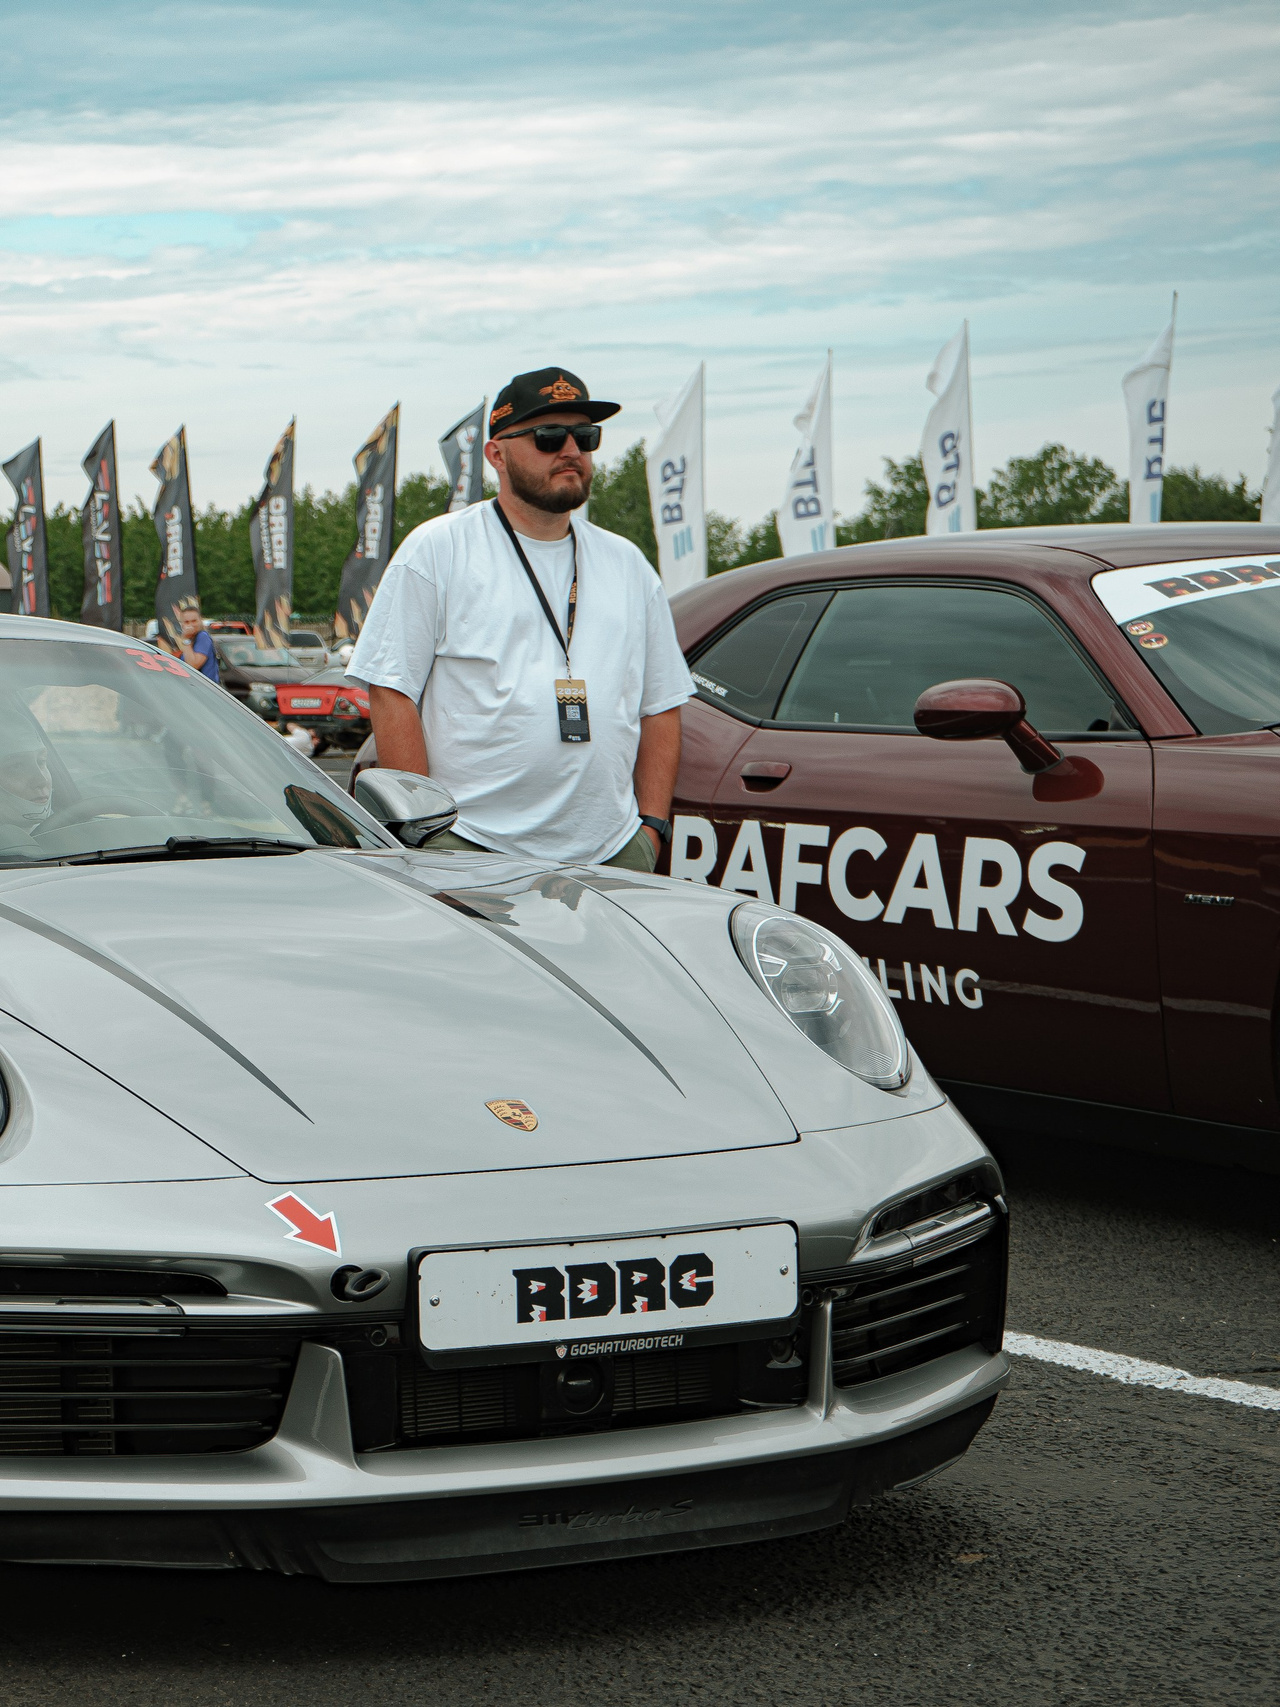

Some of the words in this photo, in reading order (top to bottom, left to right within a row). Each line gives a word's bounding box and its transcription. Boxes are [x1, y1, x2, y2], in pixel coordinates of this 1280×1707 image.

[125, 648, 191, 678] 33
[556, 687, 585, 695] 2024
[670, 814, 1087, 942] RAFCARS
[512, 1252, 714, 1324] RDRC
[570, 1334, 684, 1357] GOSHATURBOTECH
